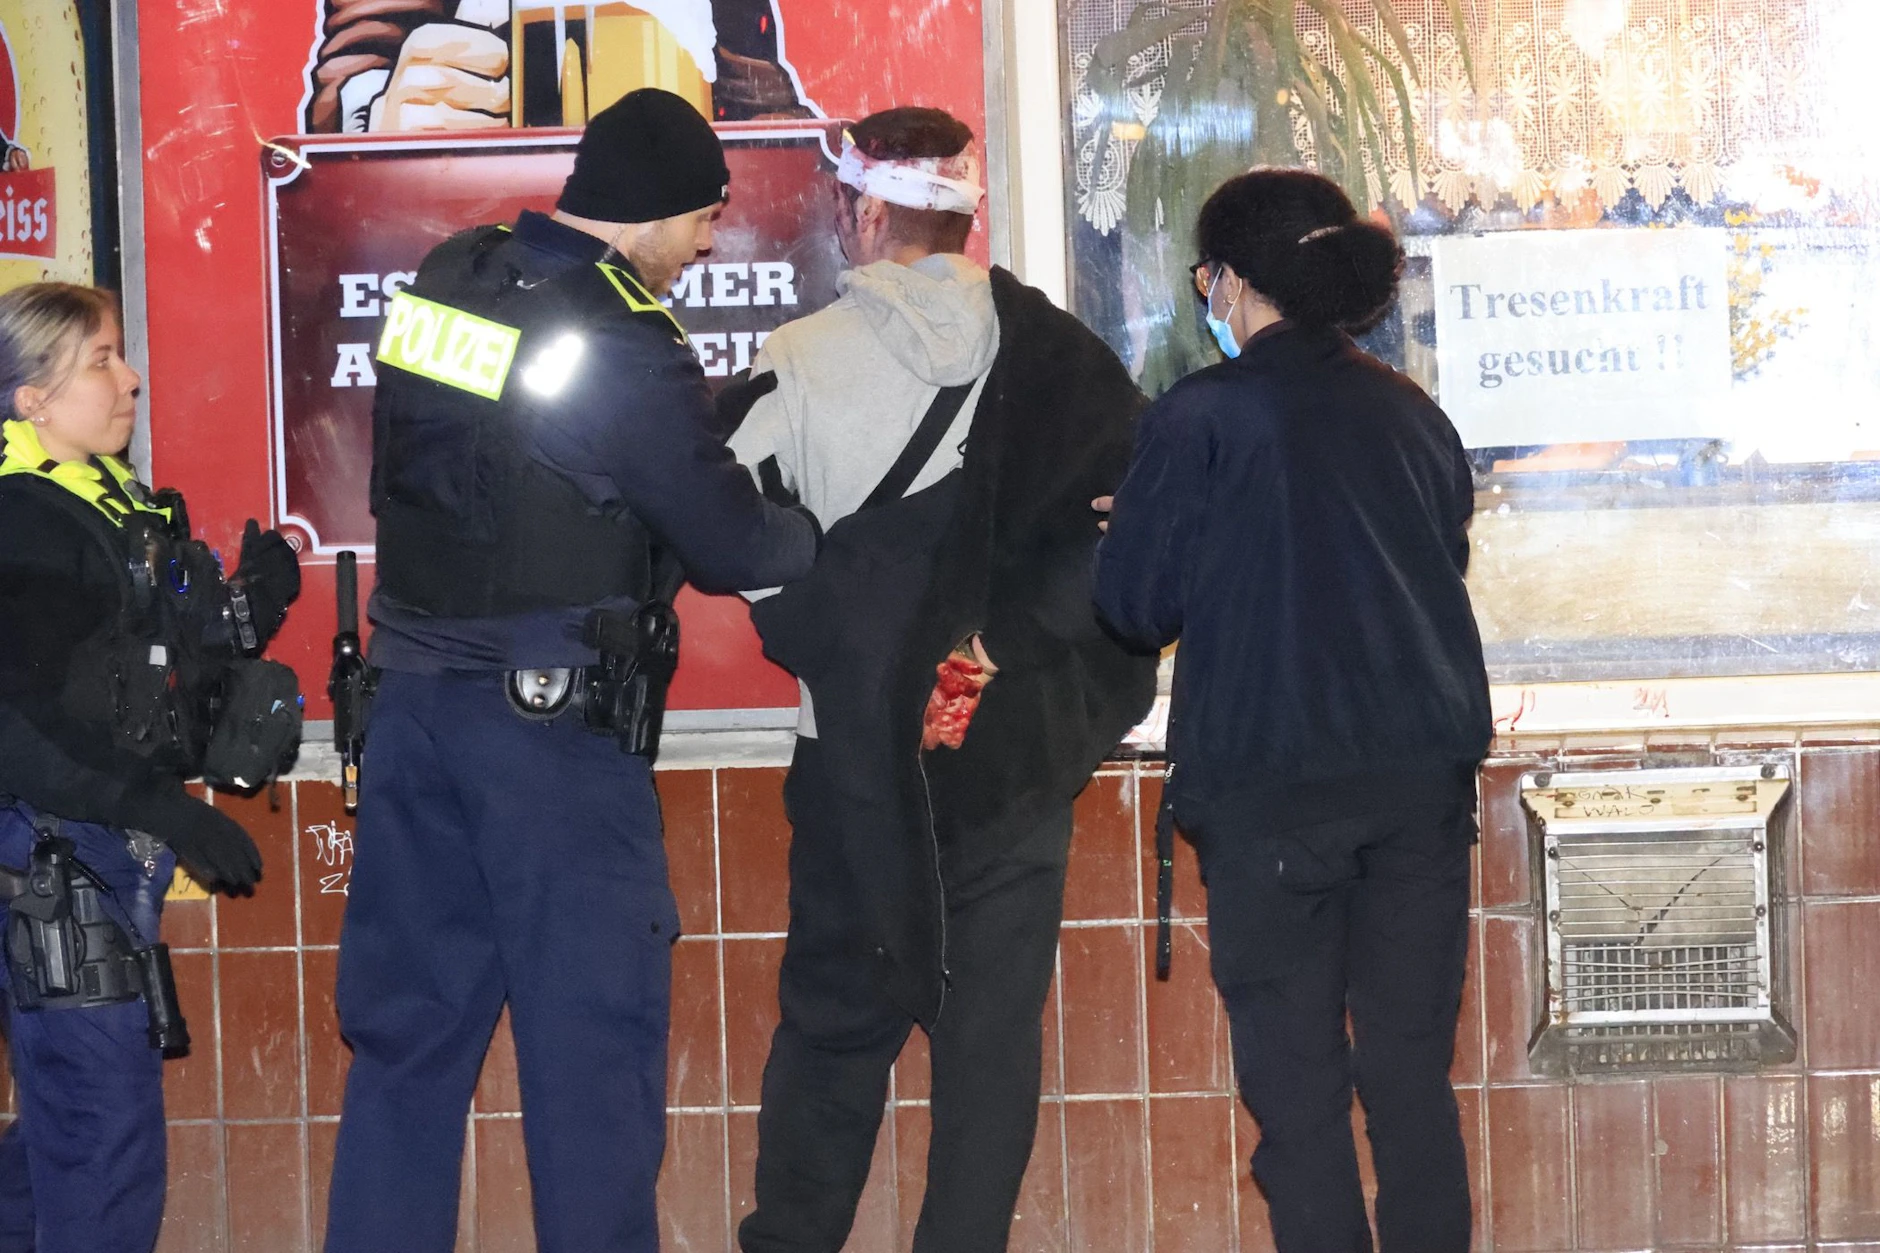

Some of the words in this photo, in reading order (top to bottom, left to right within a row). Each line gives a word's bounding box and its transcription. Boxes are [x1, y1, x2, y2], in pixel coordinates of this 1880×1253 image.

[1450, 274, 1712, 320] Tresenkraft
[378, 294, 514, 393] POLIZEI
[1478, 337, 1642, 389] gesucht
